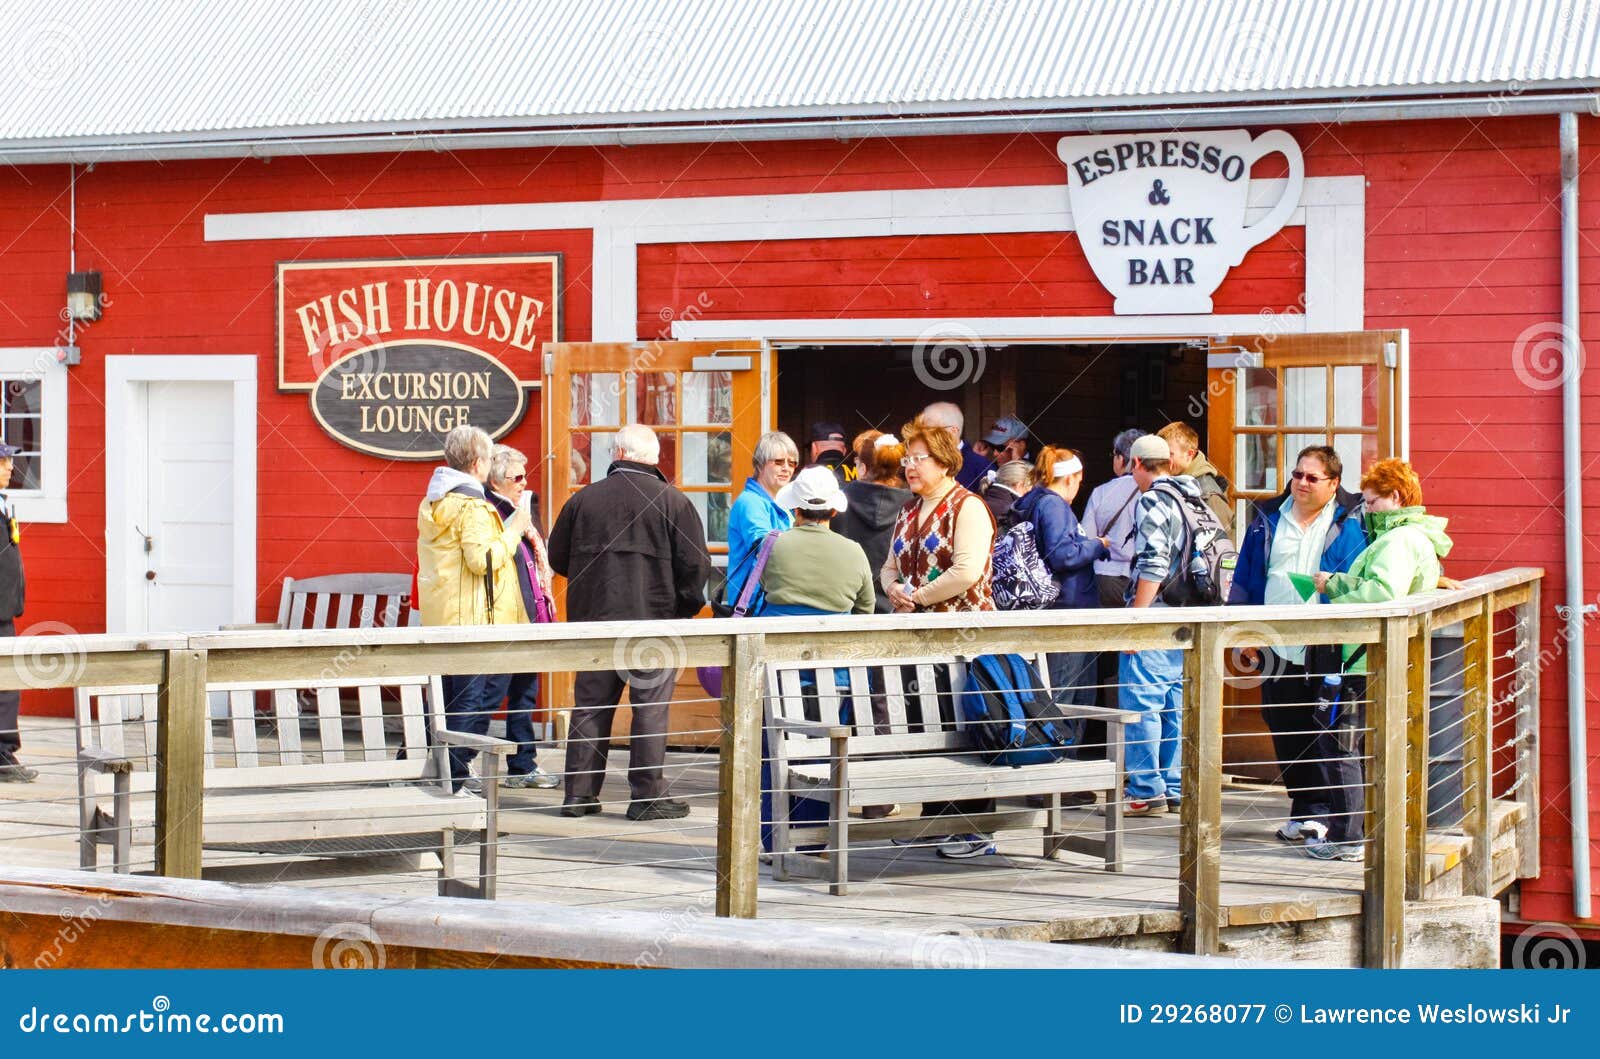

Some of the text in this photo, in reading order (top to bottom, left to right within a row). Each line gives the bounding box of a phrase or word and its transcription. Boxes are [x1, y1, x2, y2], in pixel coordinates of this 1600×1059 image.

[1072, 139, 1245, 187] ESPRESSO
[1148, 178, 1171, 206] &
[1102, 217, 1217, 246] SNACK
[1128, 257, 1195, 285] BAR
[295, 278, 544, 357] FISH HOUSE
[340, 371, 492, 401] EXCURSION
[360, 405, 470, 433] LOUNGE
